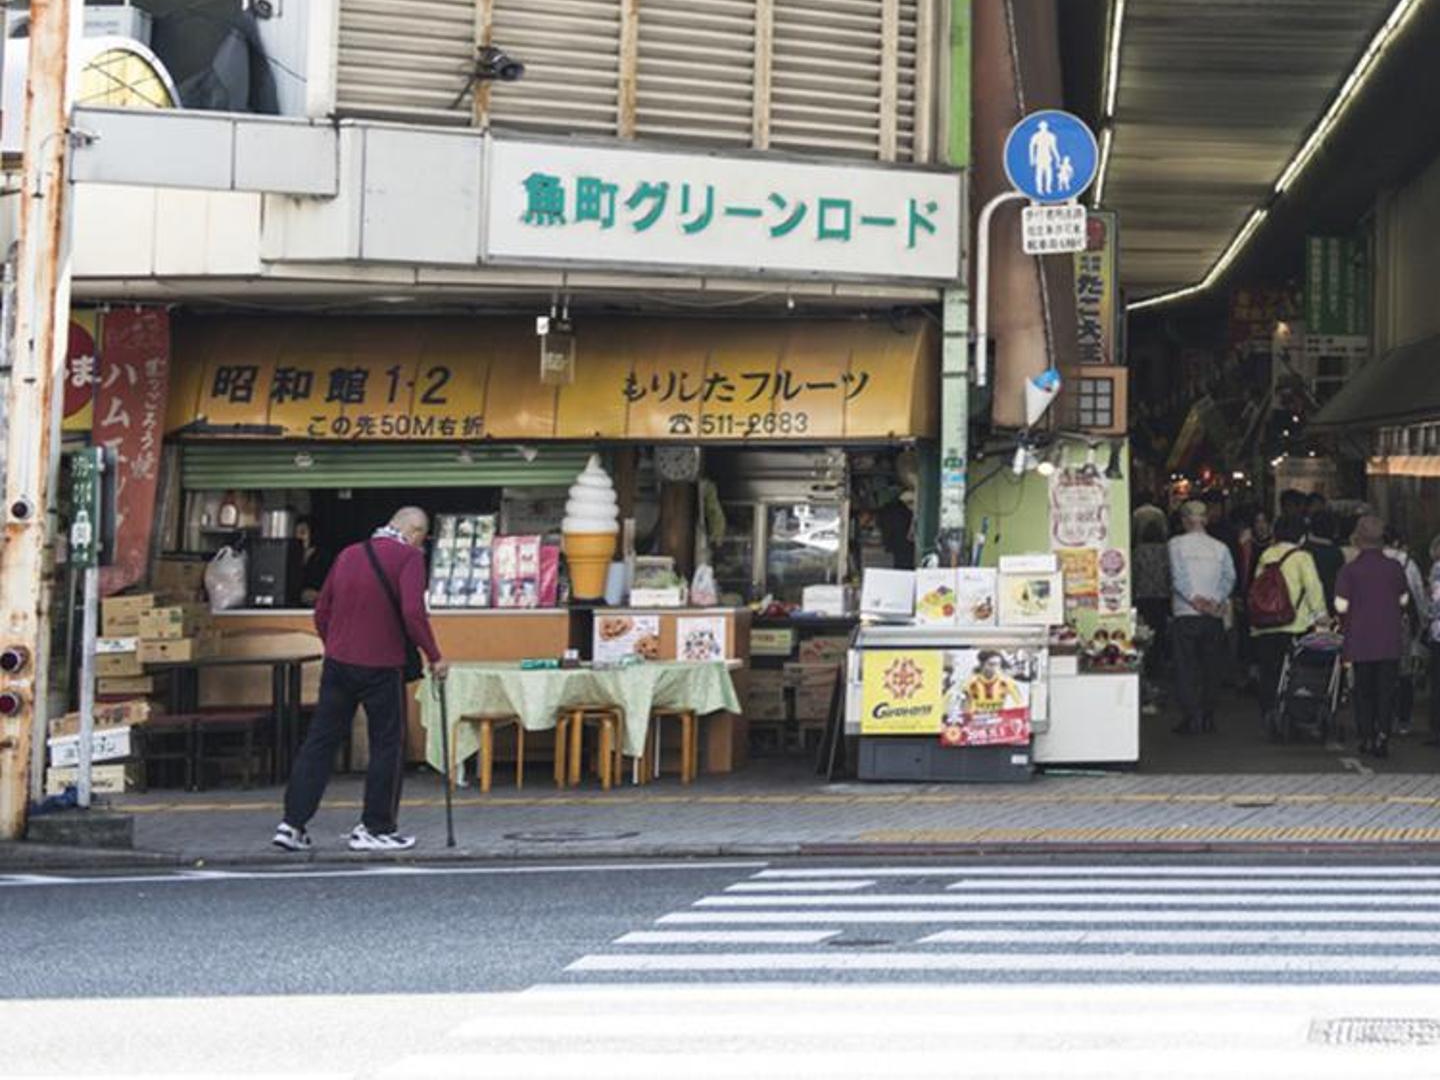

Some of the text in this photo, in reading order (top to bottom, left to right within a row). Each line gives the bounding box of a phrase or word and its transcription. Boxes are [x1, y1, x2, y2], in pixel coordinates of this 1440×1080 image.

[522, 172, 938, 249] 魚町グリーンロード
[622, 370, 869, 403] もりしたフルーツ
[306, 415, 487, 438] この先50M右折
